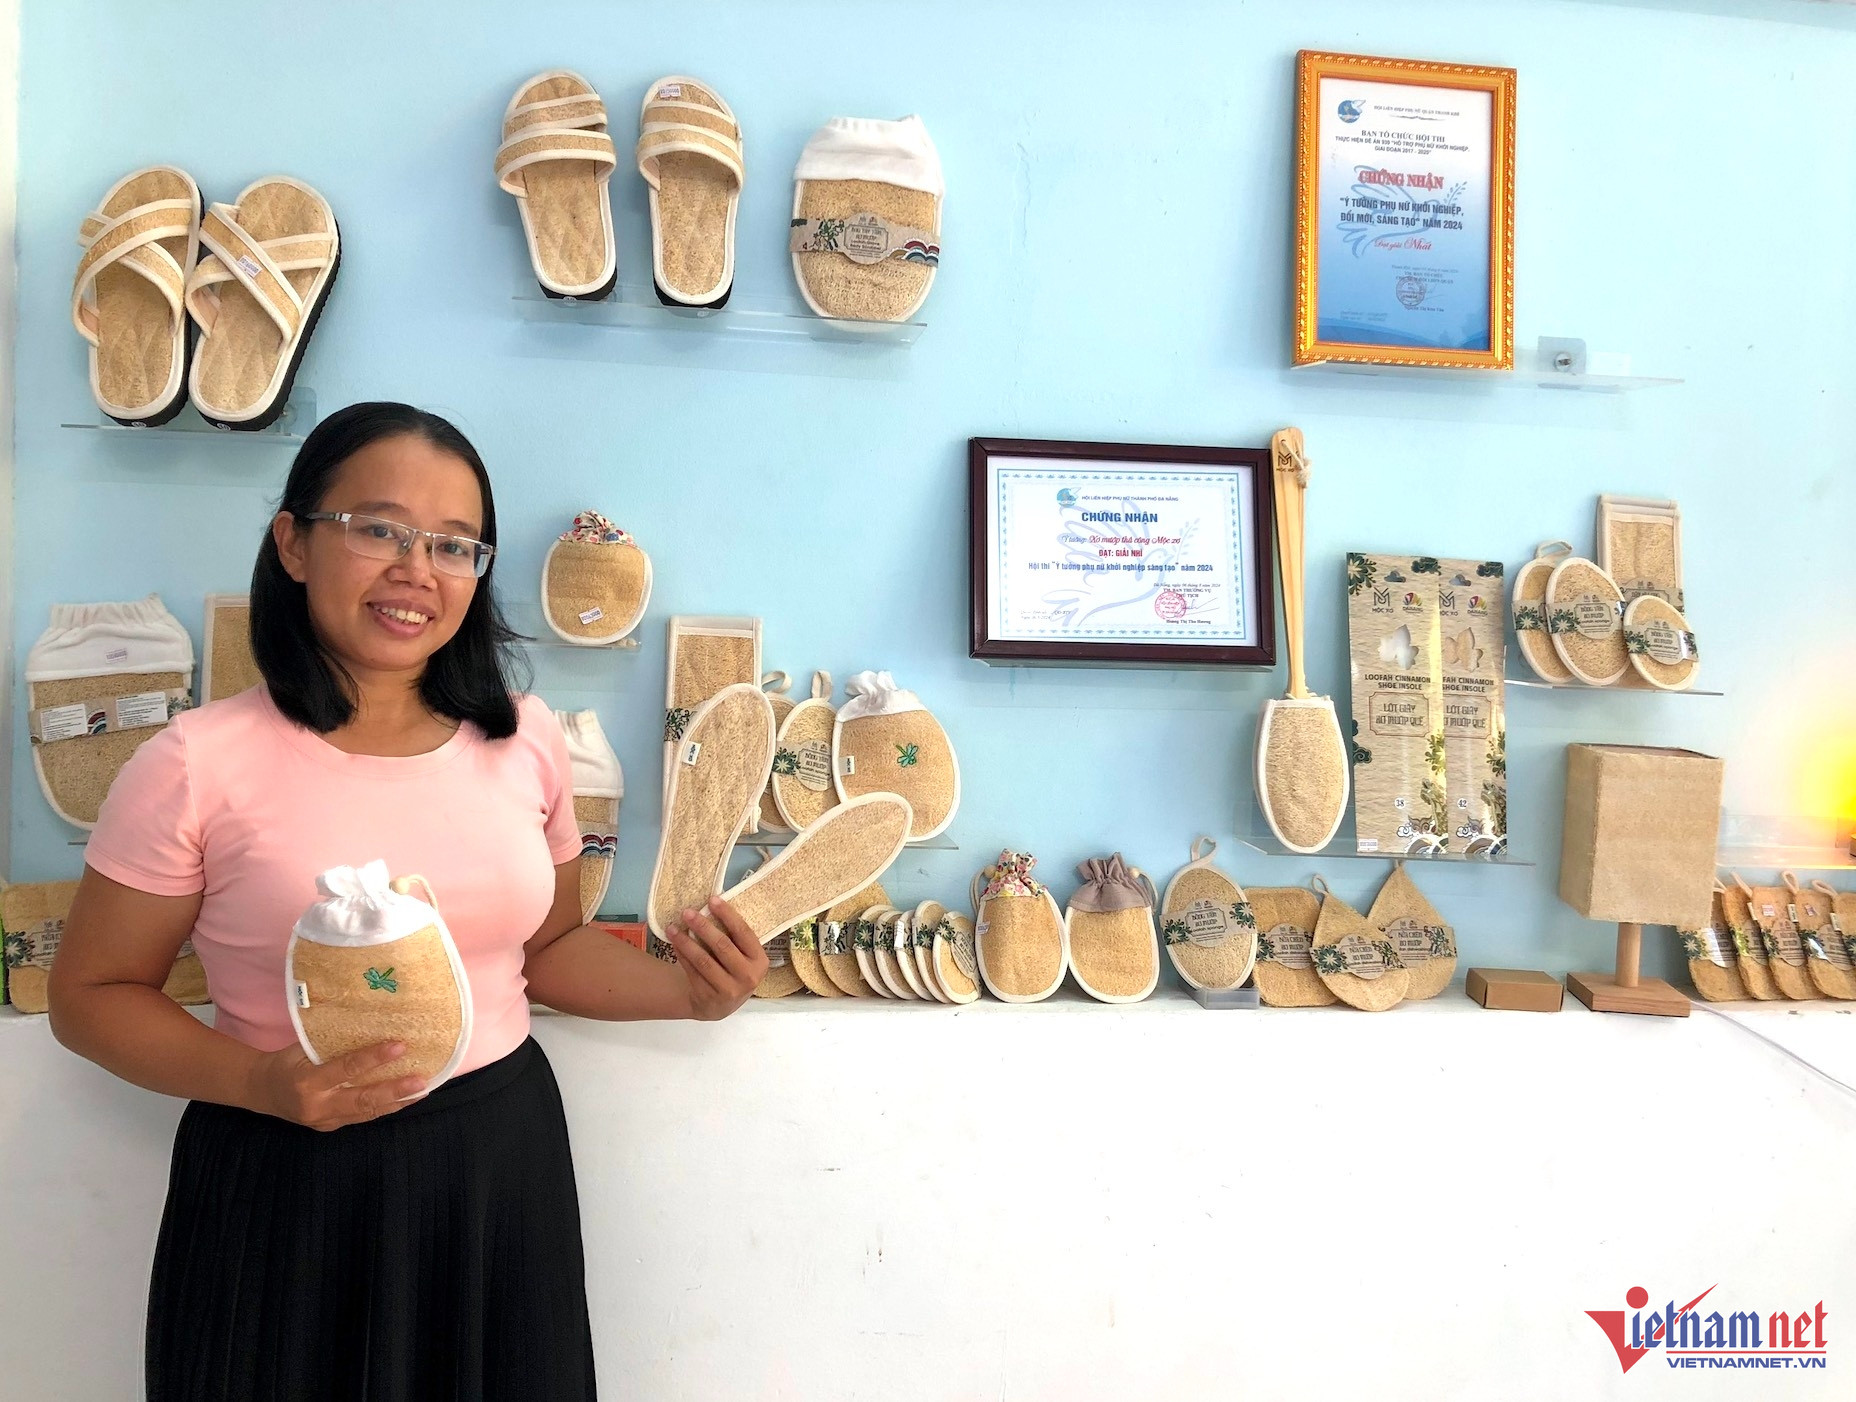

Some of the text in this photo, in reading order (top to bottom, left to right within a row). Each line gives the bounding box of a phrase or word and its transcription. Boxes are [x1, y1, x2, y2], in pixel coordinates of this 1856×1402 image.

[1358, 168, 1444, 191] CHỨNG NHẬN
[1380, 200, 1396, 212] PHỤ
[1443, 220, 1463, 230] 2024
[1081, 510, 1158, 525] CHỨNG NHẬN
[1098, 549, 1114, 558] ĐẠT:
[1115, 547, 1129, 557] GIẢI
[1028, 562, 1039, 570] Hội
[1082, 563, 1095, 571] phụ
[1122, 563, 1146, 572] nghiệp
[1196, 564, 1213, 572] 2024
[1395, 675, 1431, 683] CINNAMON
[1458, 677, 1494, 686] CINNAMON
[1462, 685, 1485, 693] INSOLE
[1396, 799, 1405, 807] 38
[1458, 799, 1467, 807] 42
